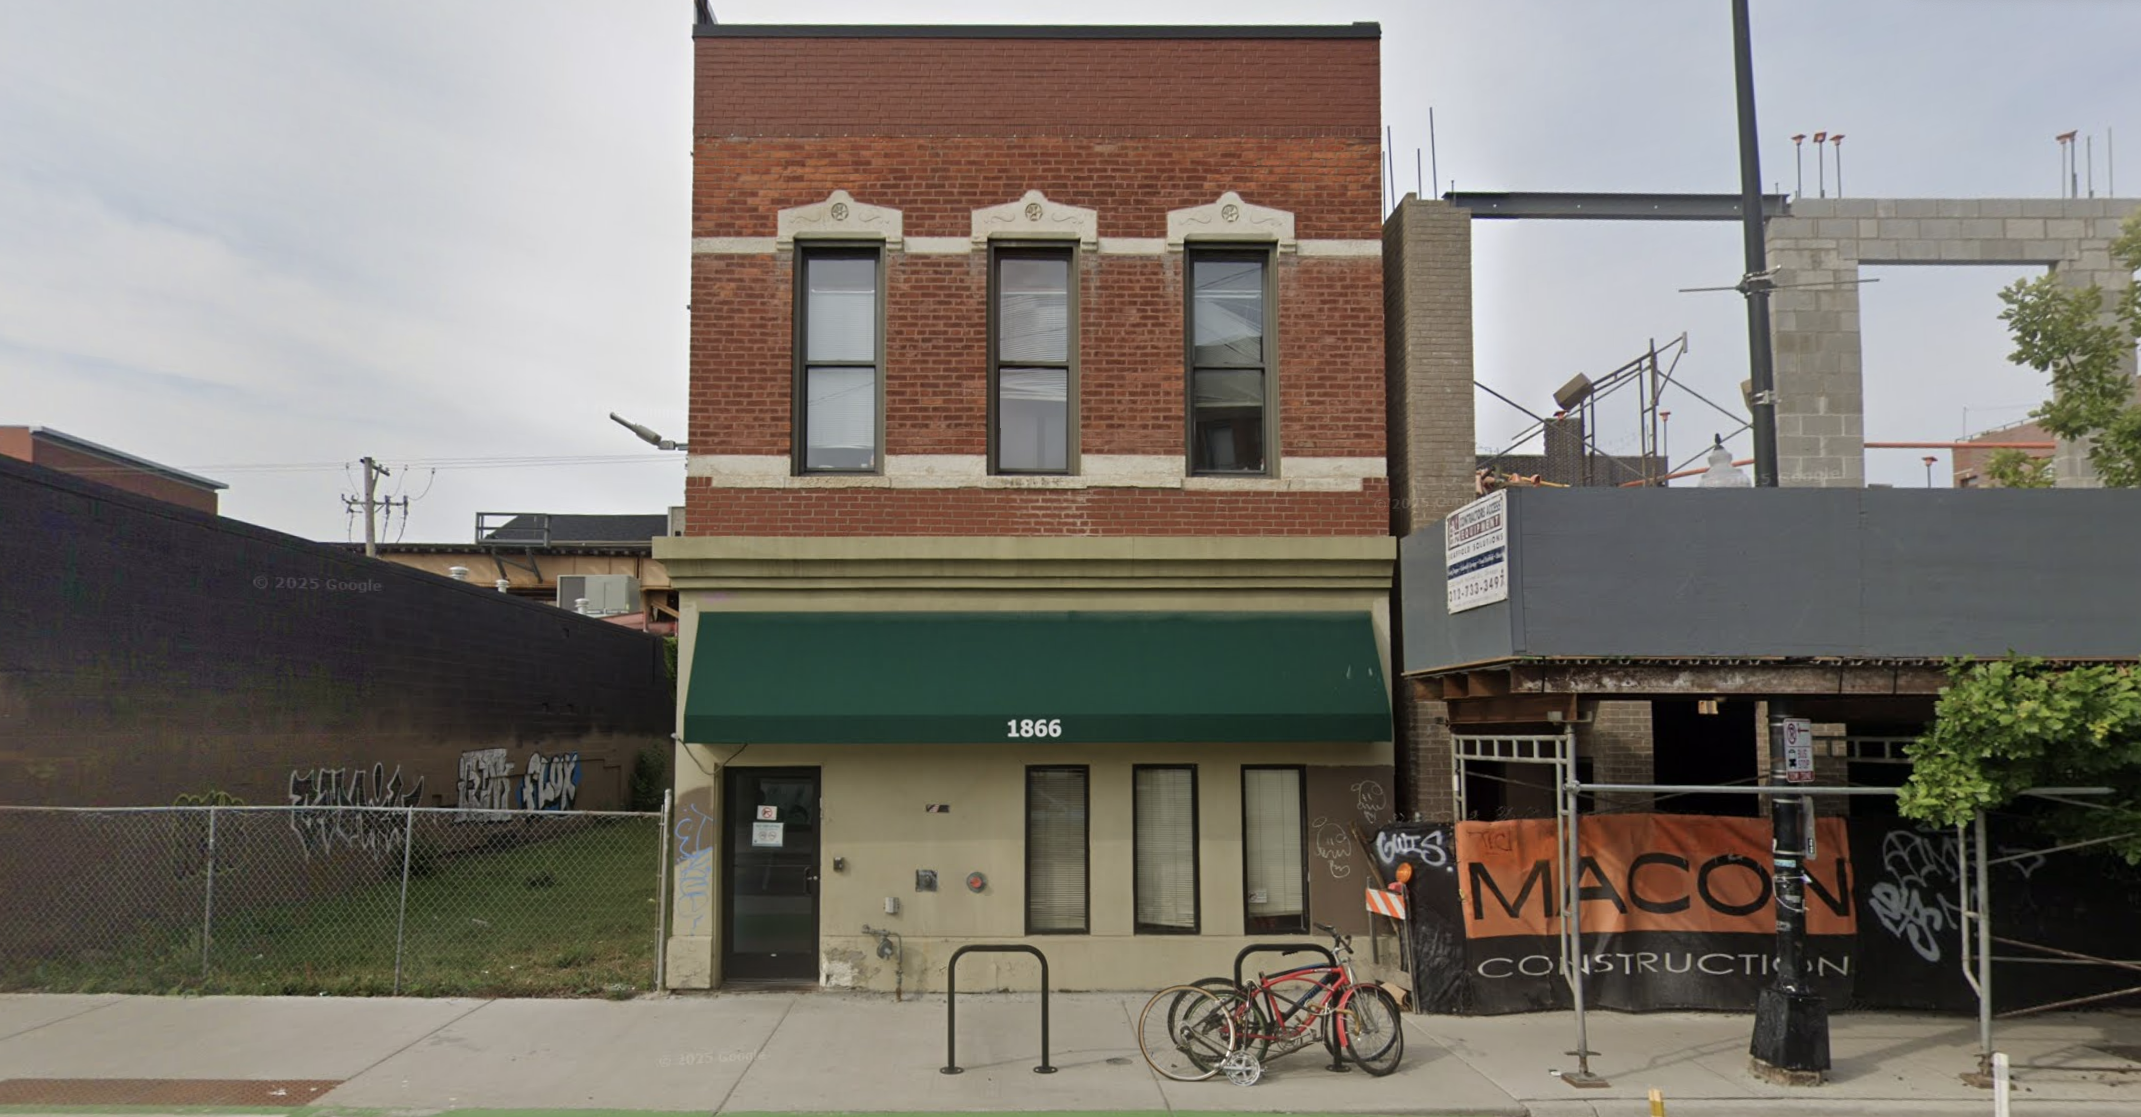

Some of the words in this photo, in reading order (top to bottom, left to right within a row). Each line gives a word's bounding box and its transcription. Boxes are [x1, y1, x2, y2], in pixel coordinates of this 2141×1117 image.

[1473, 532, 1504, 551] SOLUTIONS
[1007, 719, 1062, 738] 1866
[1468, 852, 1850, 920] MACON
[1477, 952, 1849, 980] CONSTRUCTIN
